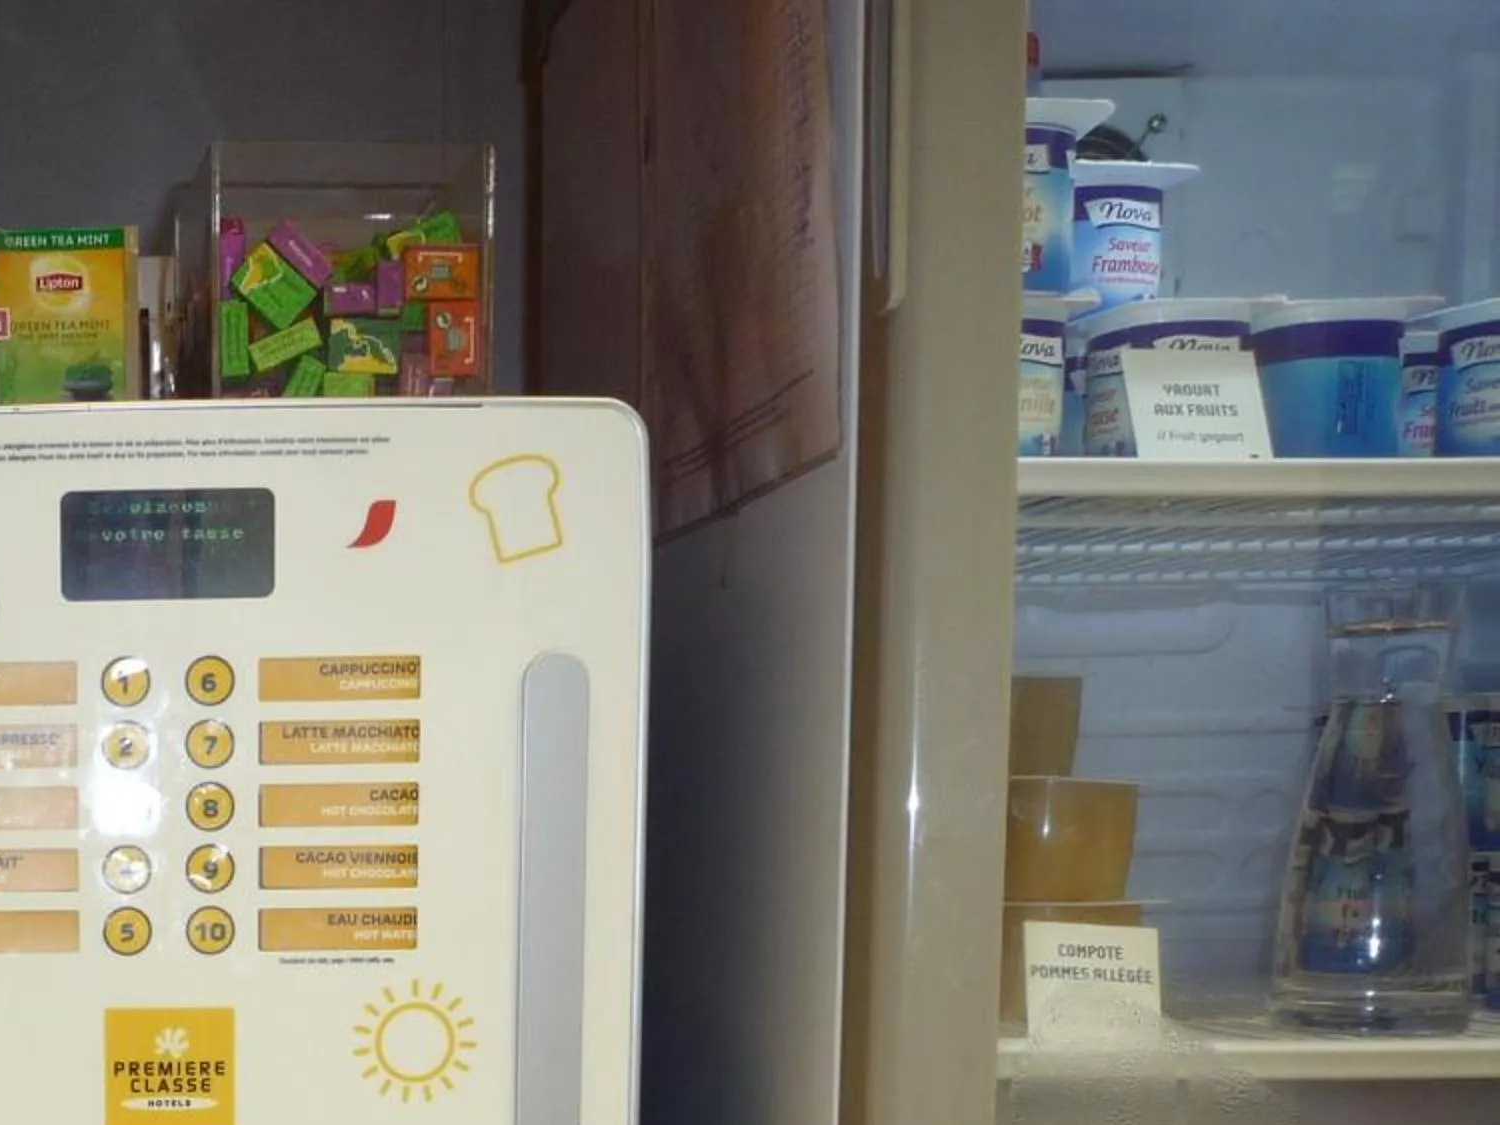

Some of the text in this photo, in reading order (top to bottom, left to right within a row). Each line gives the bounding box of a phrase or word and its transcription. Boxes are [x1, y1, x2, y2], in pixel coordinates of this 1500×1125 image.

[1100, 201, 1152, 220] Nova
[4, 234, 110, 248] GREEN TEA MINT
[39, 276, 80, 291] Lipton
[1021, 342, 1055, 356] ova
[1163, 384, 1221, 397] YAOURT
[1154, 403, 1239, 417] AUX FRUITS
[101, 528, 165, 542] votre
[201, 673, 216, 692] 6
[282, 726, 327, 739] LATTE
[118, 738, 132, 756] 2
[203, 736, 218, 754] 7
[369, 787, 419, 801] CACAO
[203, 799, 219, 818] 8
[296, 851, 346, 864] CACAO
[203, 860, 219, 879] 9
[328, 914, 357, 926] EAU
[120, 923, 135, 942] 5
[196, 922, 227, 942] 10
[1058, 944, 1125, 960] COMPOTE
[1031, 964, 1154, 985] POMMES ALLÉGÉE
[113, 1060, 226, 1077] PREMIERE
[130, 1077, 212, 1093] CLASSE
[148, 1099, 191, 1107] HOTELS
